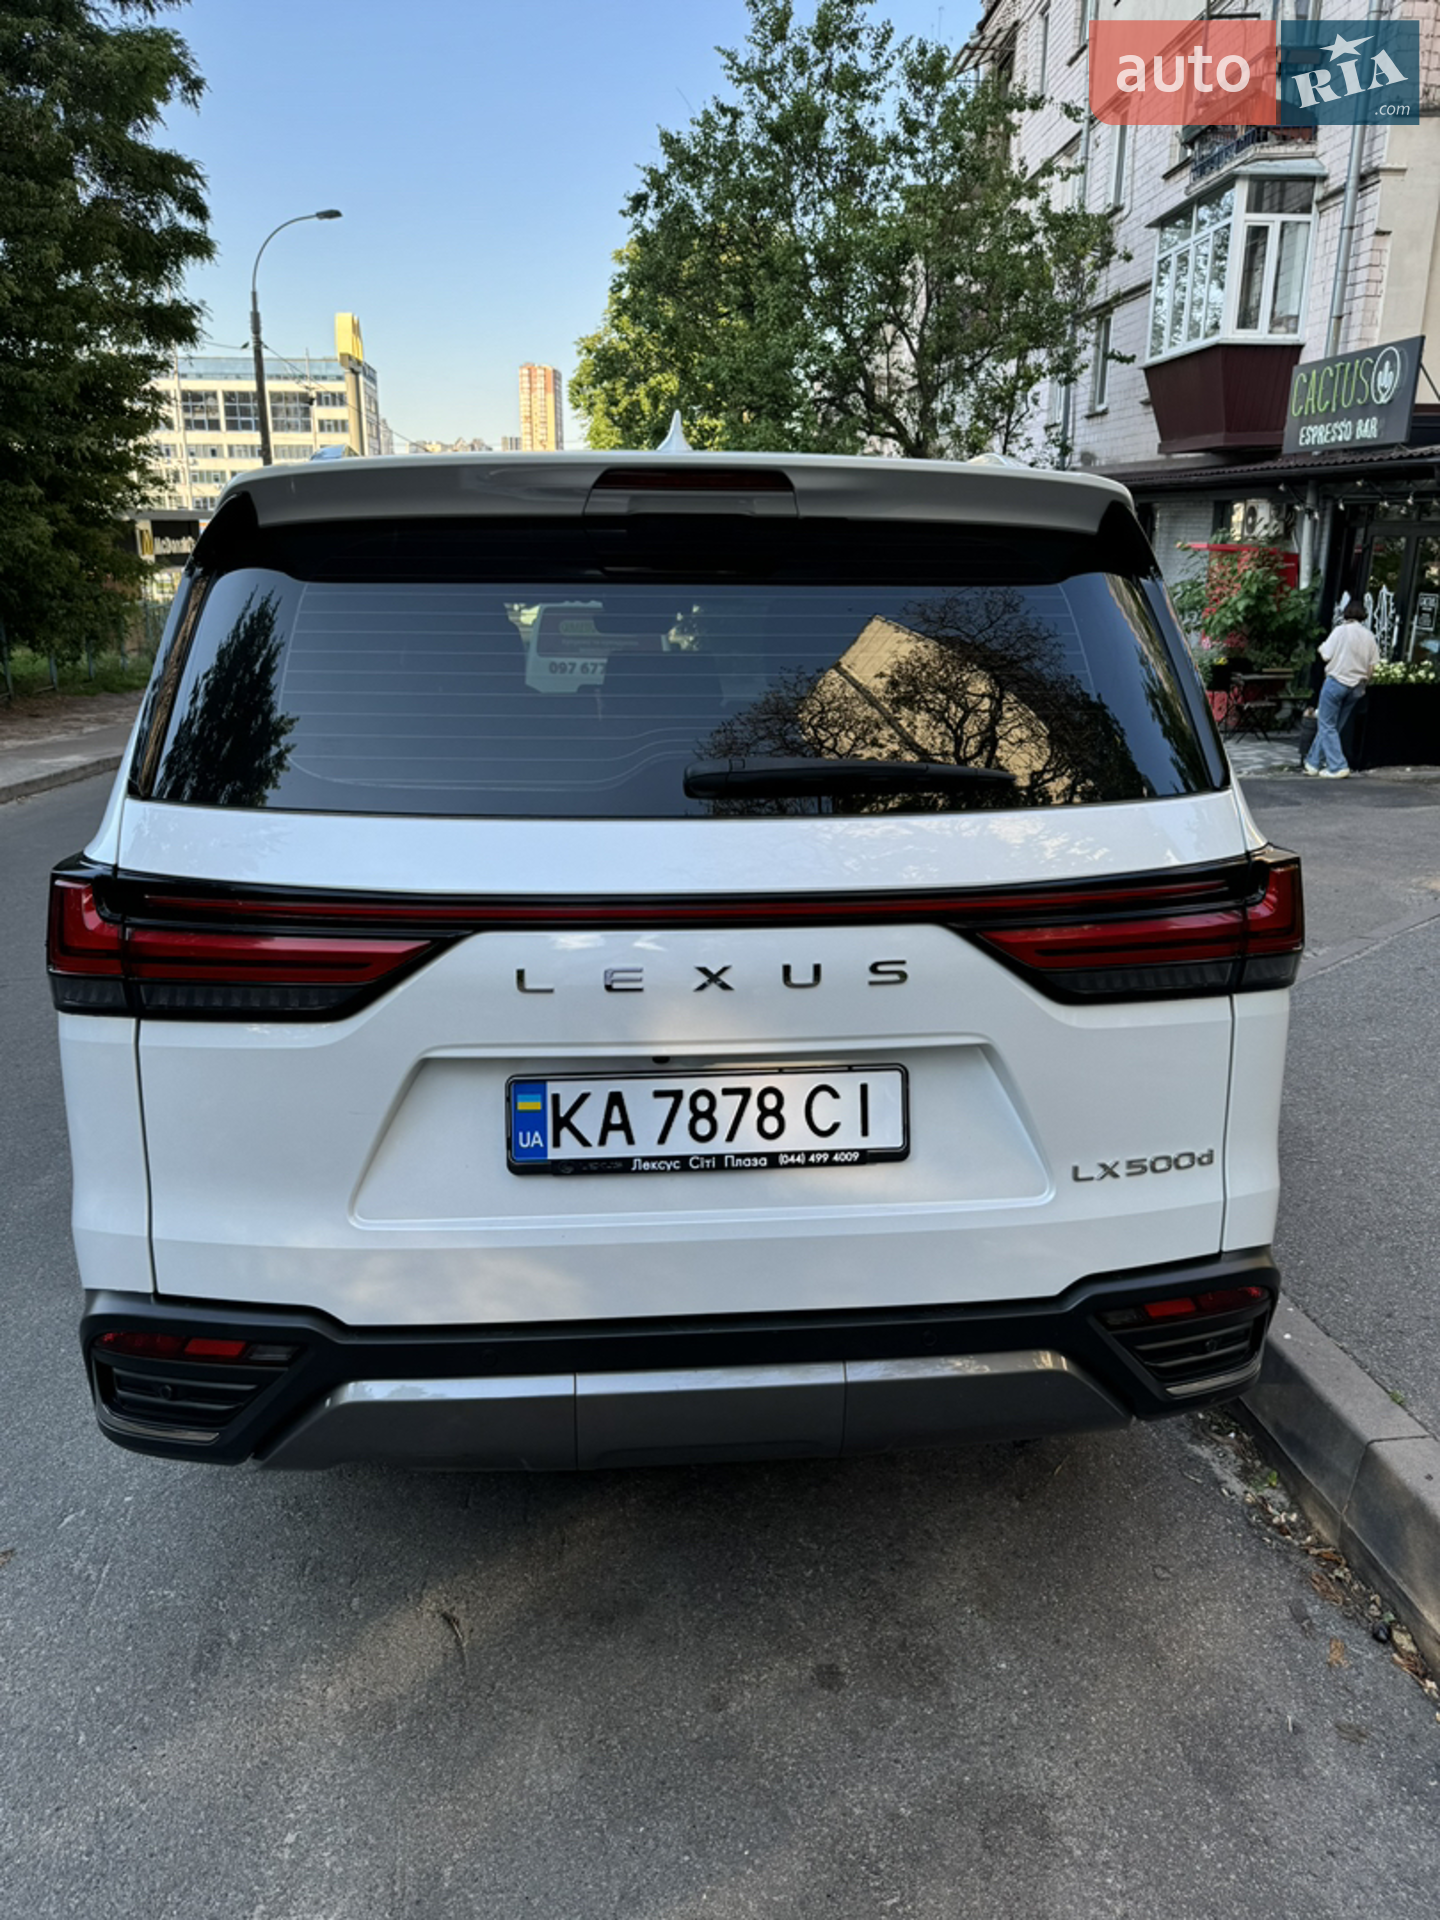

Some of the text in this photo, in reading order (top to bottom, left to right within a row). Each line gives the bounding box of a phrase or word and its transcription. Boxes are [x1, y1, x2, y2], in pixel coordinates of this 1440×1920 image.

[1291, 356, 1374, 417] CACTUS
[1298, 417, 1378, 446] ESPRESSO BAR
[548, 662, 577, 675] 097
[516, 960, 909, 994] LEXUS
[653, 1086, 785, 1145] 7878
[518, 1131, 545, 1148] UA
[631, 1158, 681, 1172] Лексус
[689, 1155, 716, 1169] Сіті
[724, 1154, 767, 1168] Плаза
[779, 1152, 806, 1166] (044)
[808, 1152, 829, 1163] 499
[832, 1151, 860, 1162] 4009
